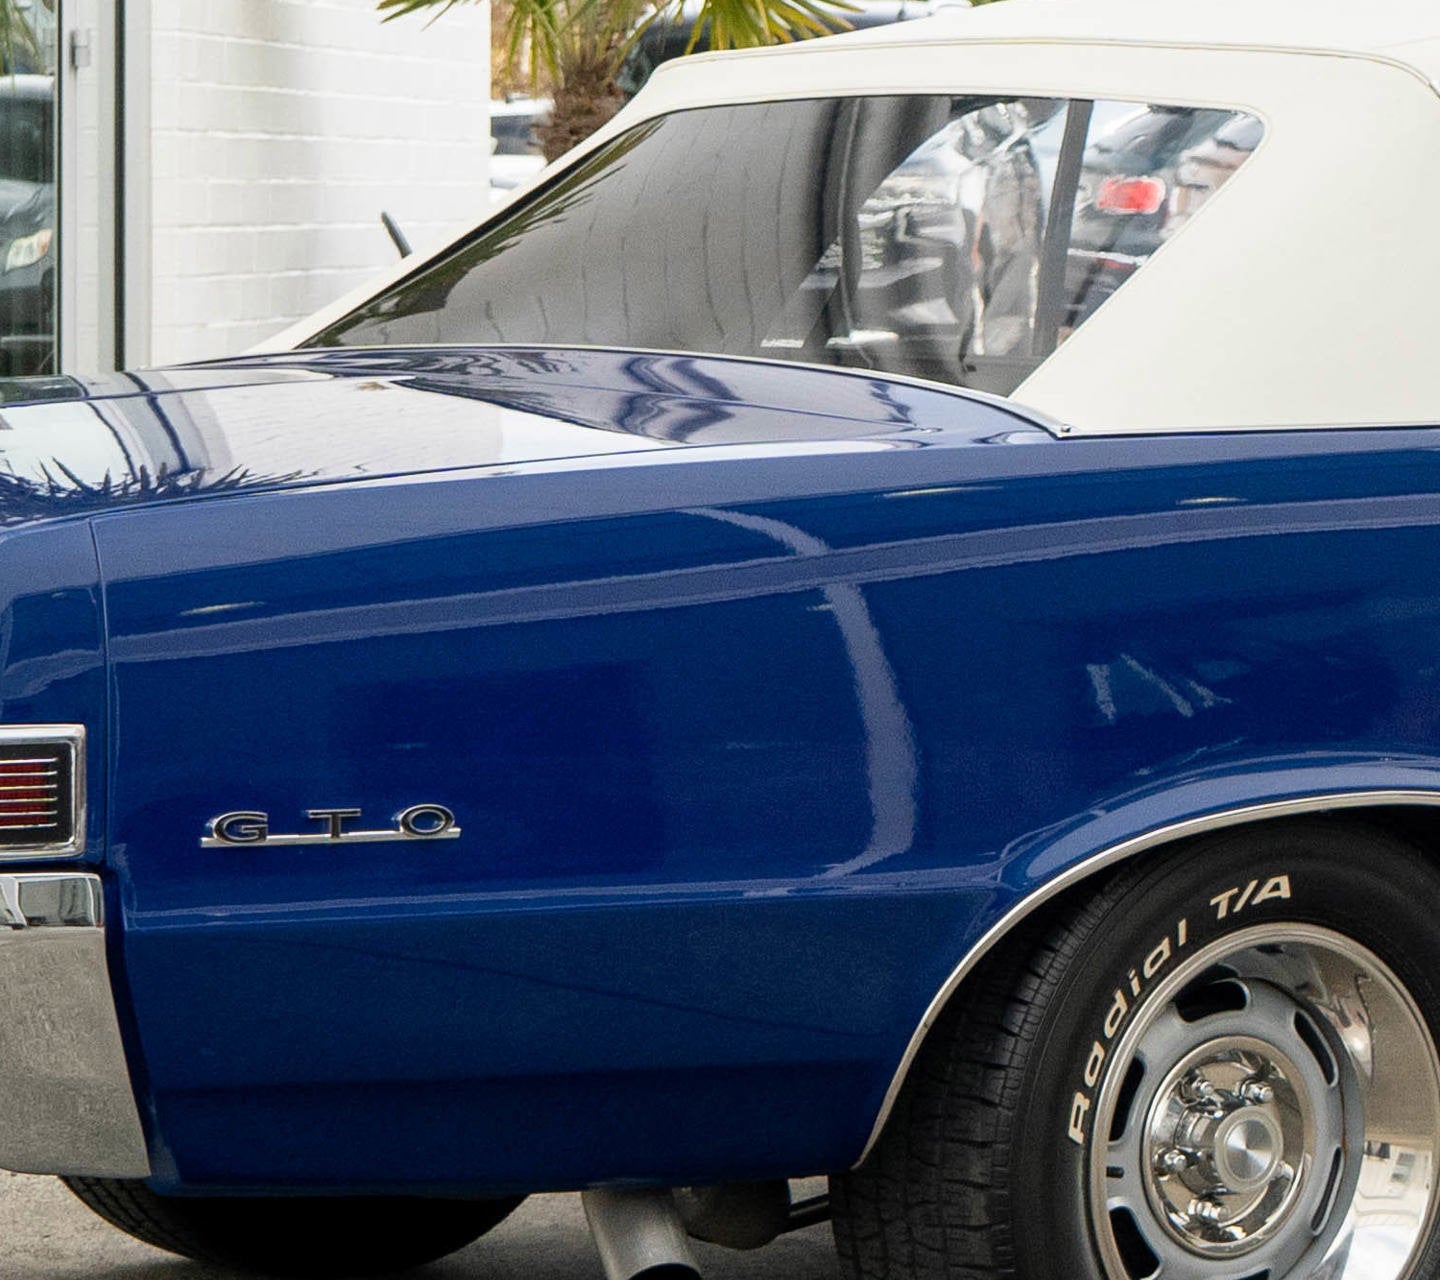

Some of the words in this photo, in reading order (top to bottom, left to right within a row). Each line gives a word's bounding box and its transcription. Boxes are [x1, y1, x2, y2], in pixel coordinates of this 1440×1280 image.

[203, 803, 458, 846] GTO
[1068, 919, 1188, 1145] Radial
[1210, 874, 1293, 920] T/A
